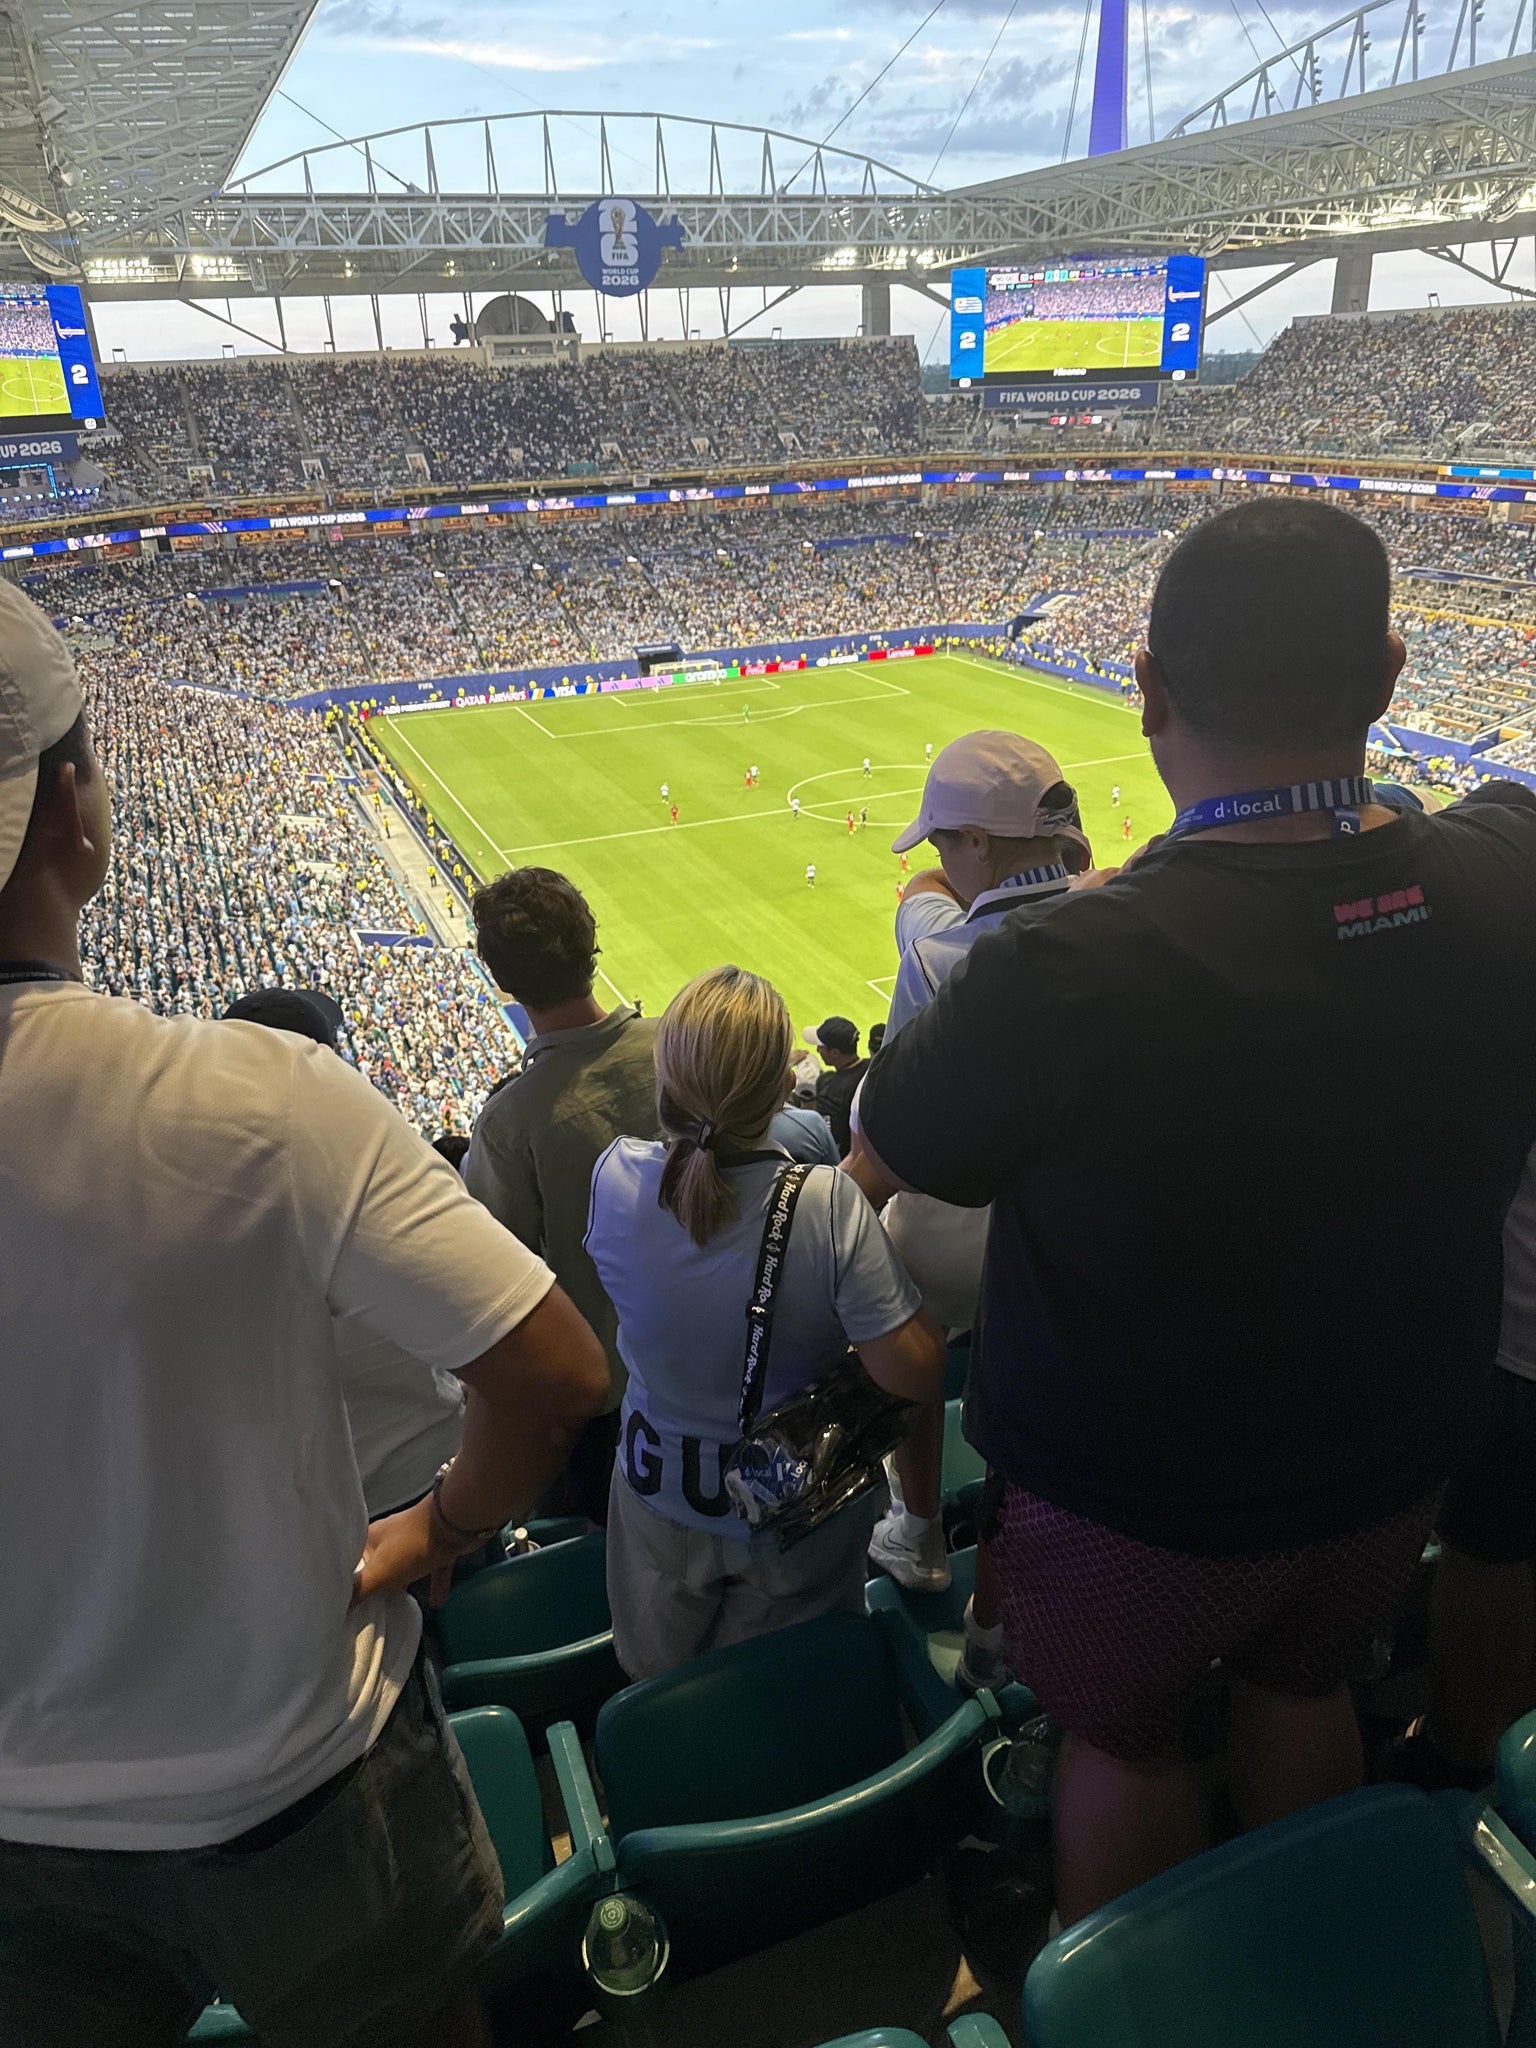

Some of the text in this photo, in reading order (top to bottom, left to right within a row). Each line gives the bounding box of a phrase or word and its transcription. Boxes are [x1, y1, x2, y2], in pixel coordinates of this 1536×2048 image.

[612, 252, 629, 260] FIFA
[602, 276, 640, 285] 2026
[959, 332, 976, 349] 2
[1171, 323, 1190, 341] 2
[71, 364, 89, 384] 2
[1000, 388, 1141, 403] FIFA WORLD CUP 2026
[0, 441, 62, 458] UP 2026
[886, 475, 899, 484] CUP
[1411, 484, 1437, 494] 2026
[270, 512, 366, 528] FIFA WORLD CUP 2026
[887, 649, 915, 659] Lenovo
[418, 682, 434, 690] FIFA
[552, 685, 577, 697] VISA
[456, 690, 526, 708] QATAR AIRWAYS
[1337, 905, 1428, 940] MIAMI
[768, 1181, 797, 1241] Hard Rock
[762, 1254, 779, 1288] Hard
[744, 1324, 764, 1384] Hard Rock
[623, 1410, 736, 1517] GU
